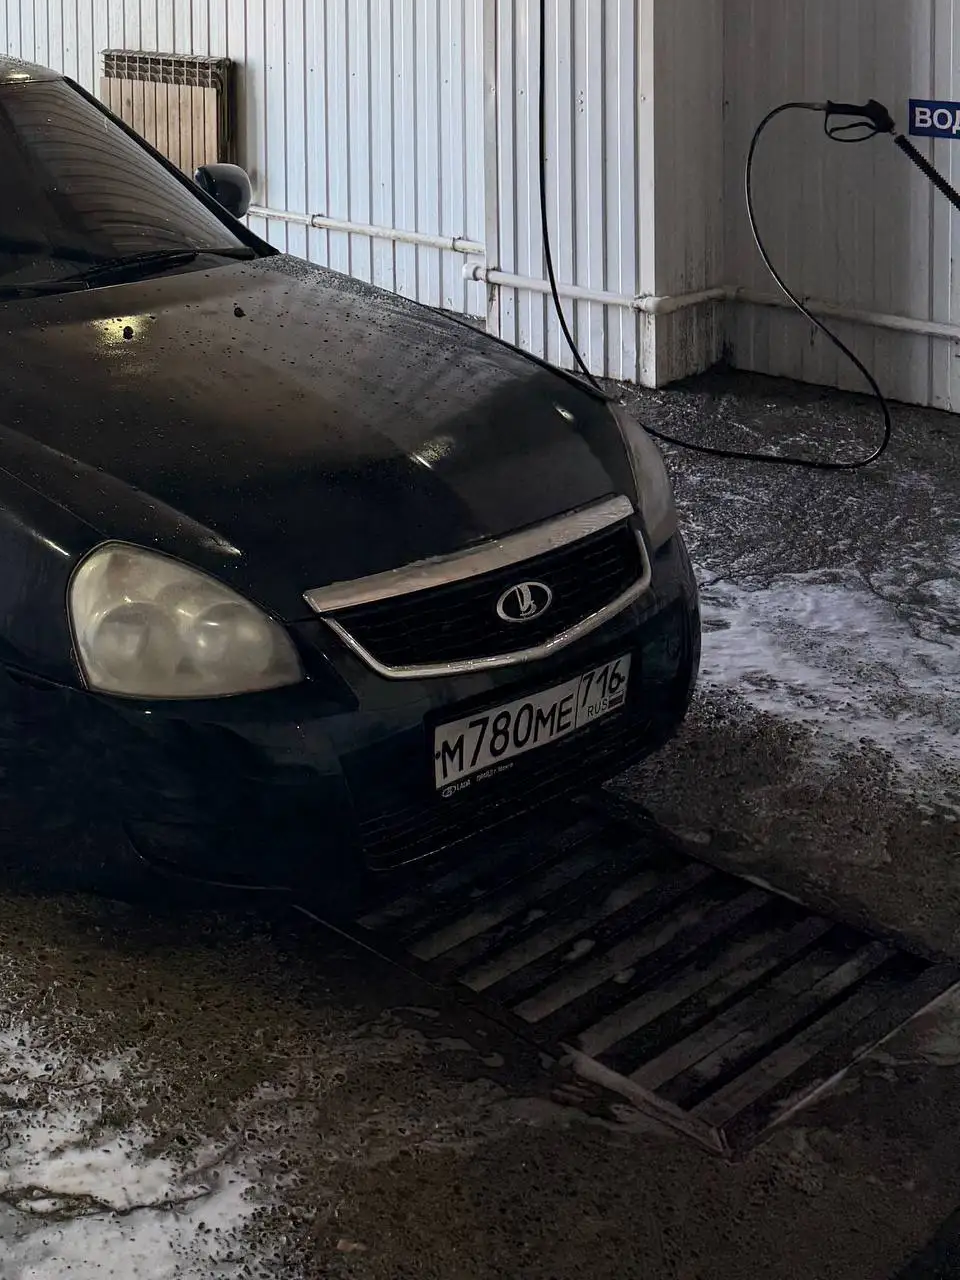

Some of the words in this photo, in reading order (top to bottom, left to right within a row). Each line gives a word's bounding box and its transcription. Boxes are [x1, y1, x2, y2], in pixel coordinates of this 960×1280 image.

[441, 694, 574, 779] М780МЕ
[582, 660, 622, 708] 716
[587, 697, 609, 717] RUS
